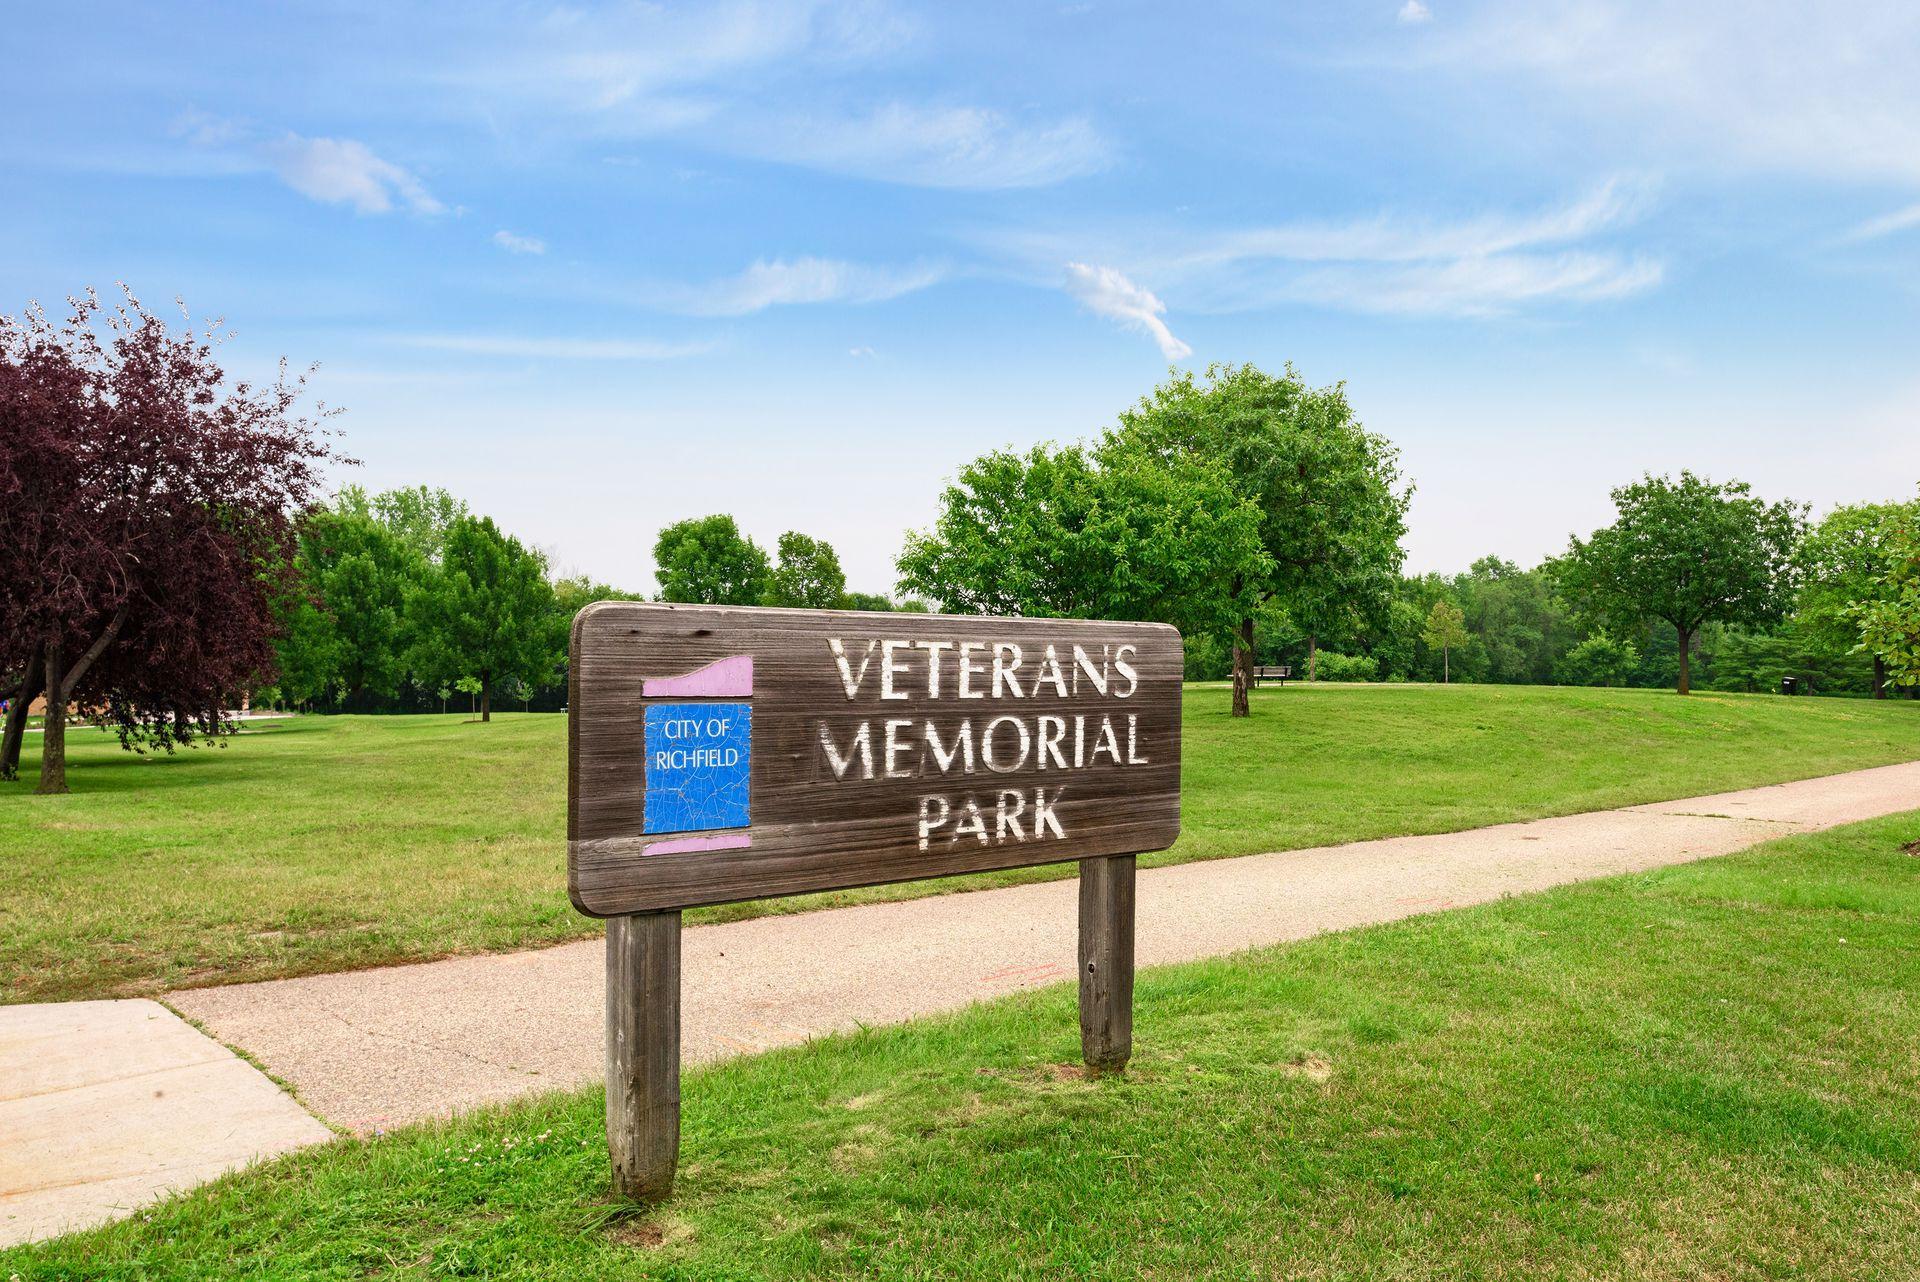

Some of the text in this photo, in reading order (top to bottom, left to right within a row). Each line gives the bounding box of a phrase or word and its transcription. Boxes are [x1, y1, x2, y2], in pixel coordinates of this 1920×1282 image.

[827, 638, 1138, 700] VETERANS
[656, 748, 739, 770] RICHFIELD
[665, 718, 730, 739] CITY OF
[810, 713, 1149, 783] MEMORIAL
[918, 786, 1068, 852] PARK
